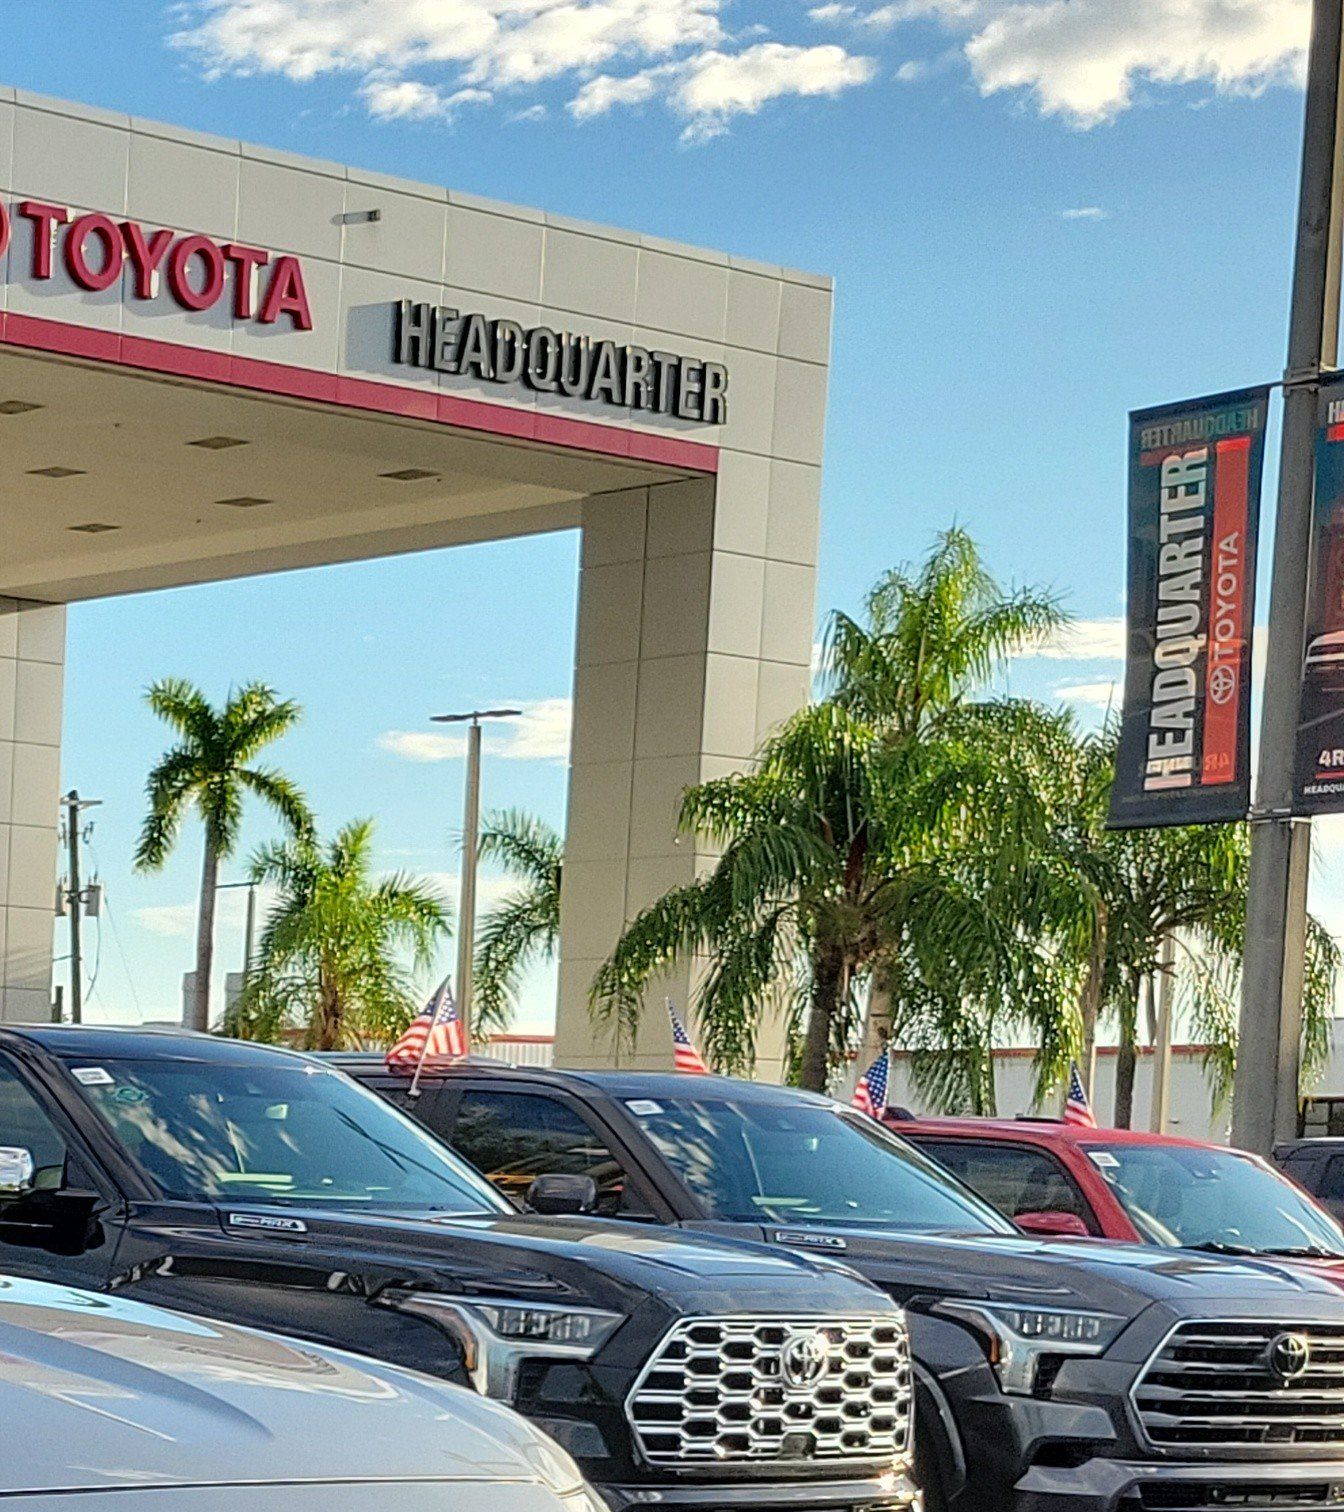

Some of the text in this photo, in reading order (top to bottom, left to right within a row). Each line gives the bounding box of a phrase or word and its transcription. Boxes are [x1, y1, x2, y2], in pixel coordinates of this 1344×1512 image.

[19, 200, 313, 331] TOYOTA
[394, 299, 729, 425] HEADQUARTER
[1143, 446, 1208, 791] HEADQUARTER
[1212, 530, 1239, 661] TOYOTA
